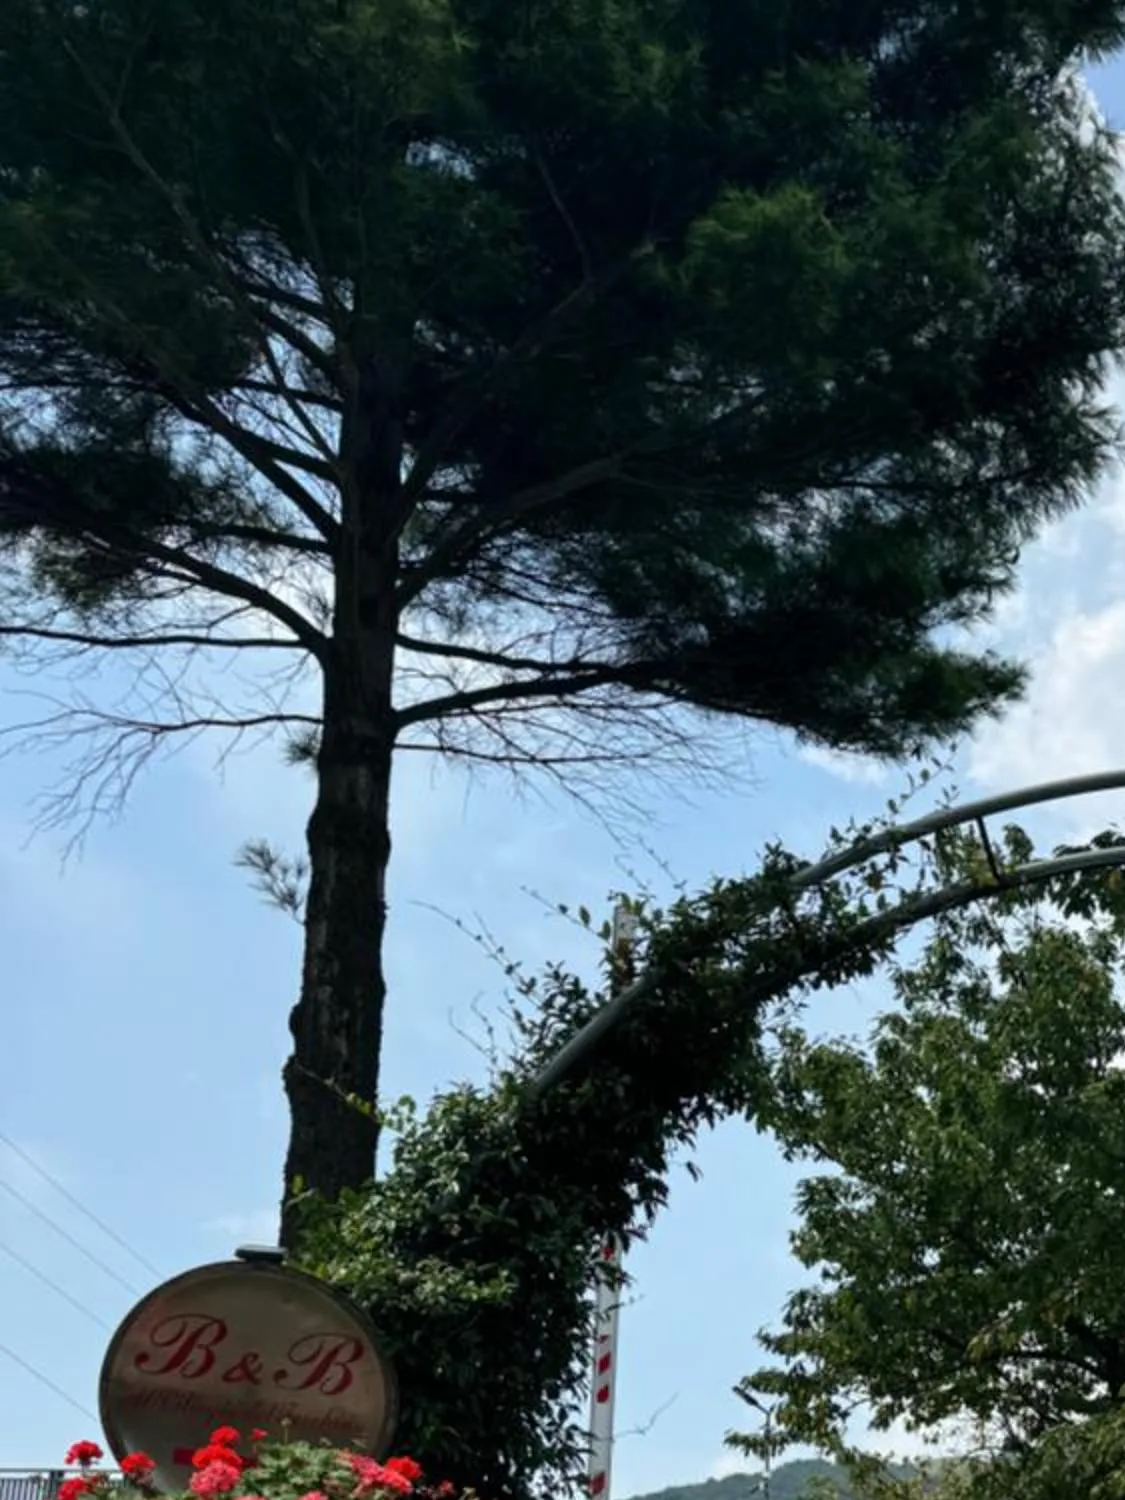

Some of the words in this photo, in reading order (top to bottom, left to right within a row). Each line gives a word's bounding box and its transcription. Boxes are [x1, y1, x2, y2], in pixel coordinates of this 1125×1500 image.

[134, 1313, 227, 1379] B
[221, 1352, 265, 1386] &
[273, 1332, 365, 1396] B
